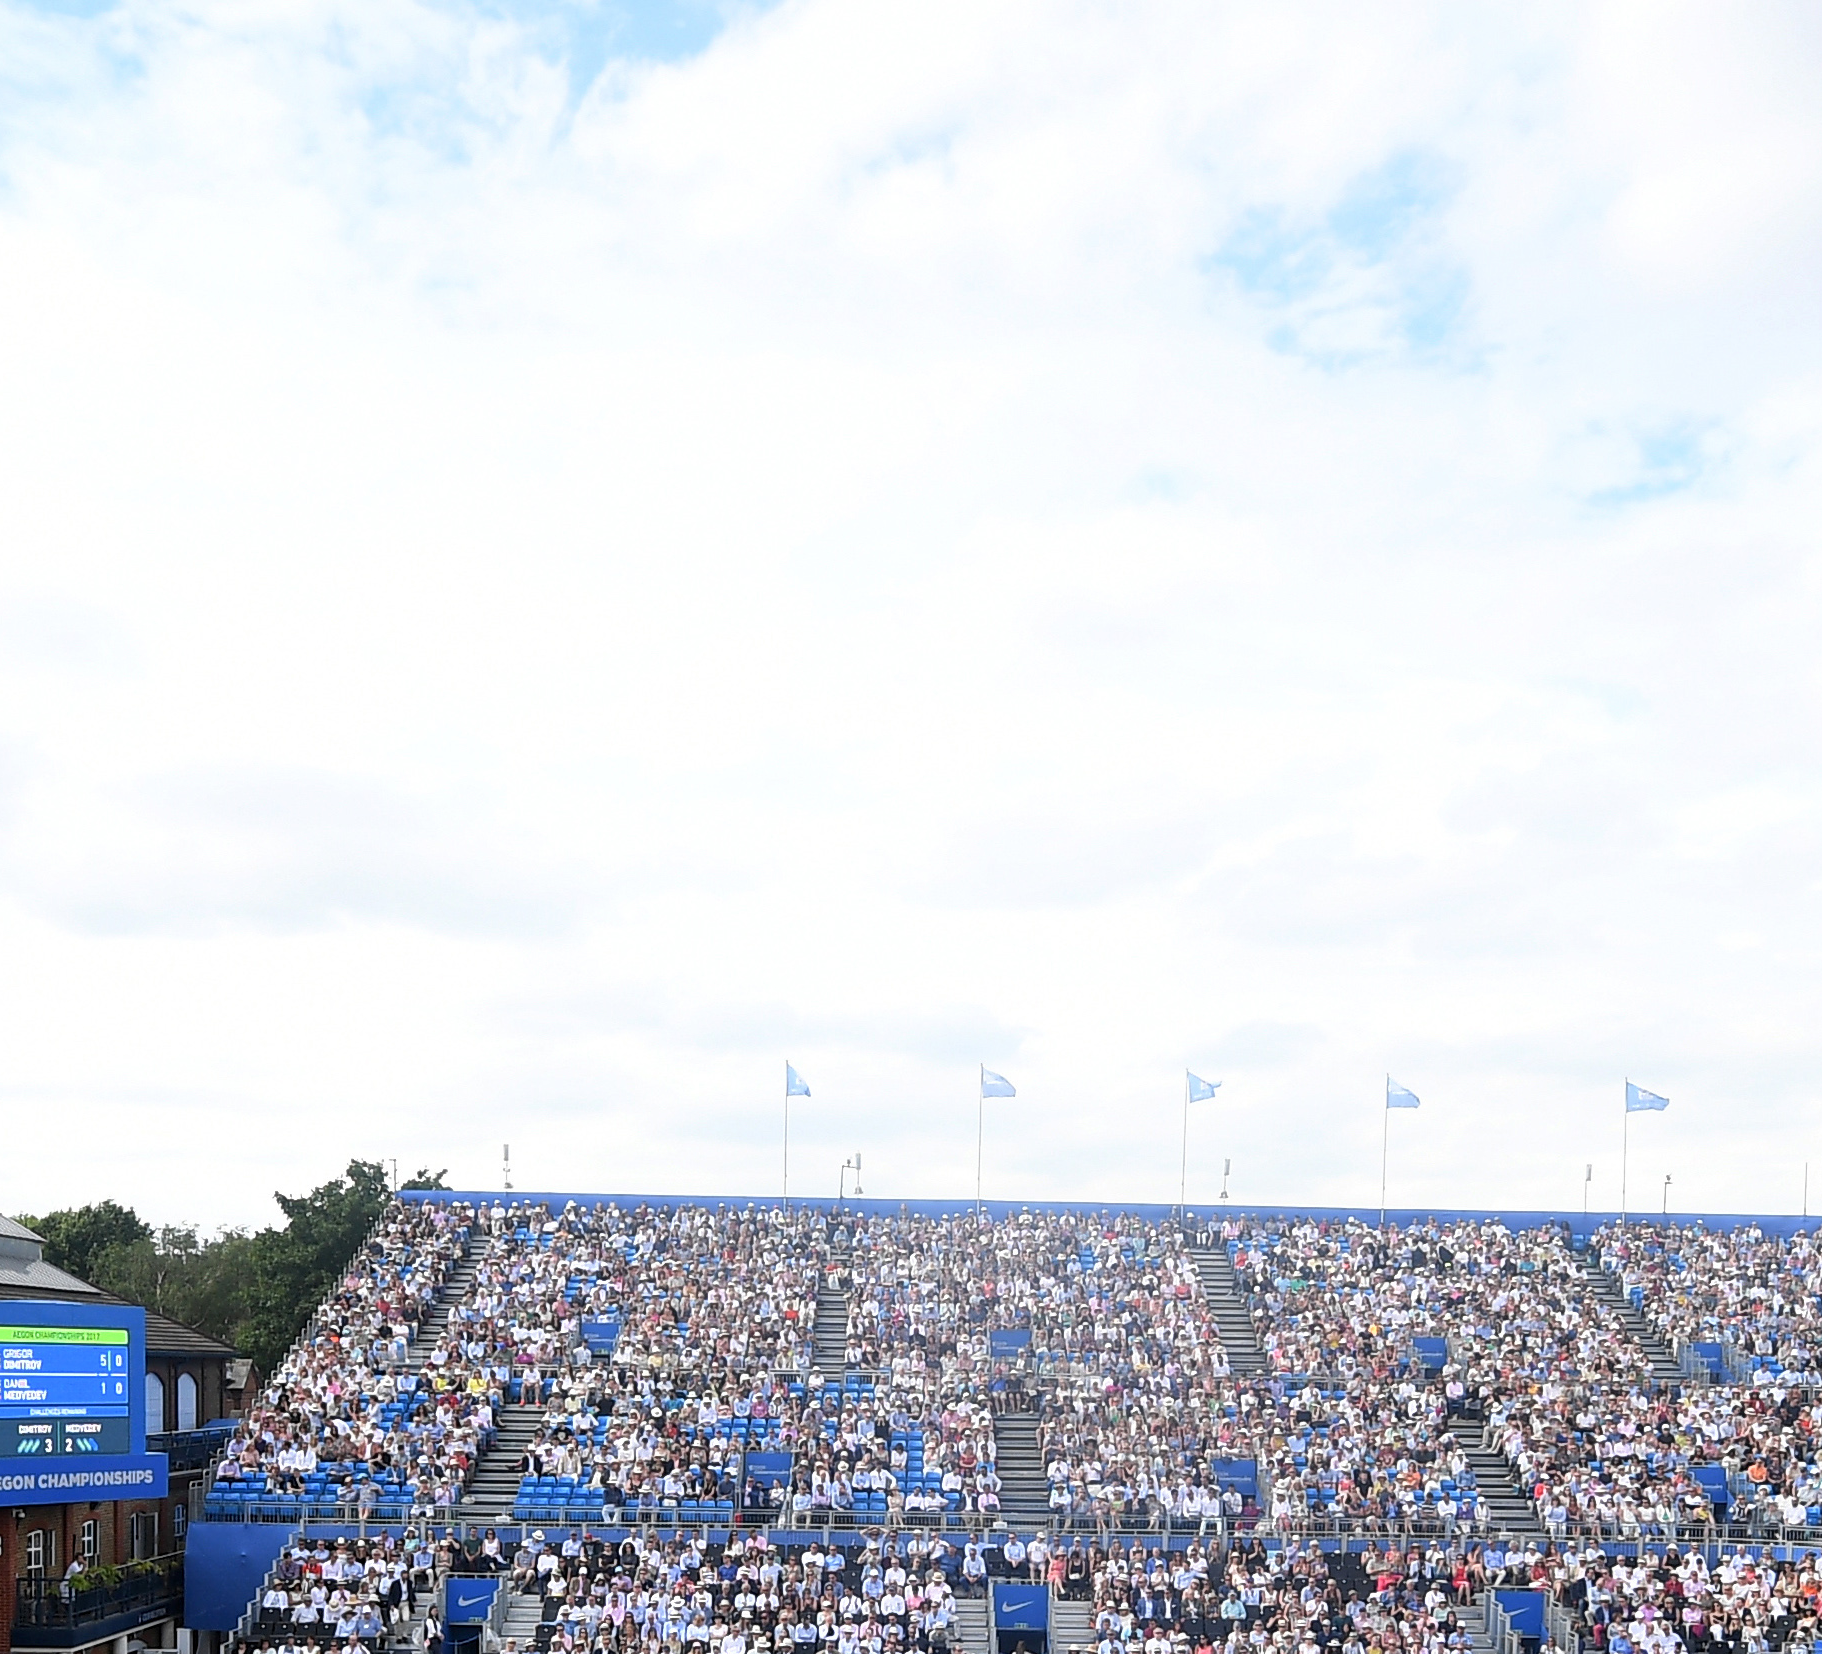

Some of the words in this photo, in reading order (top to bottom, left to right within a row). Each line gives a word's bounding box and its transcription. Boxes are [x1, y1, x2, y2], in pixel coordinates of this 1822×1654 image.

[3, 1360, 42, 1370] DIMITROV
[100, 1354, 107, 1367] 5
[115, 1354, 122, 1367] 0
[101, 1382, 106, 1394] 1
[115, 1382, 122, 1394] 0
[45, 1438, 52, 1453] 3
[65, 1438, 73, 1452] 2
[38, 1469, 154, 1489] CHAMPIONSHIPS
